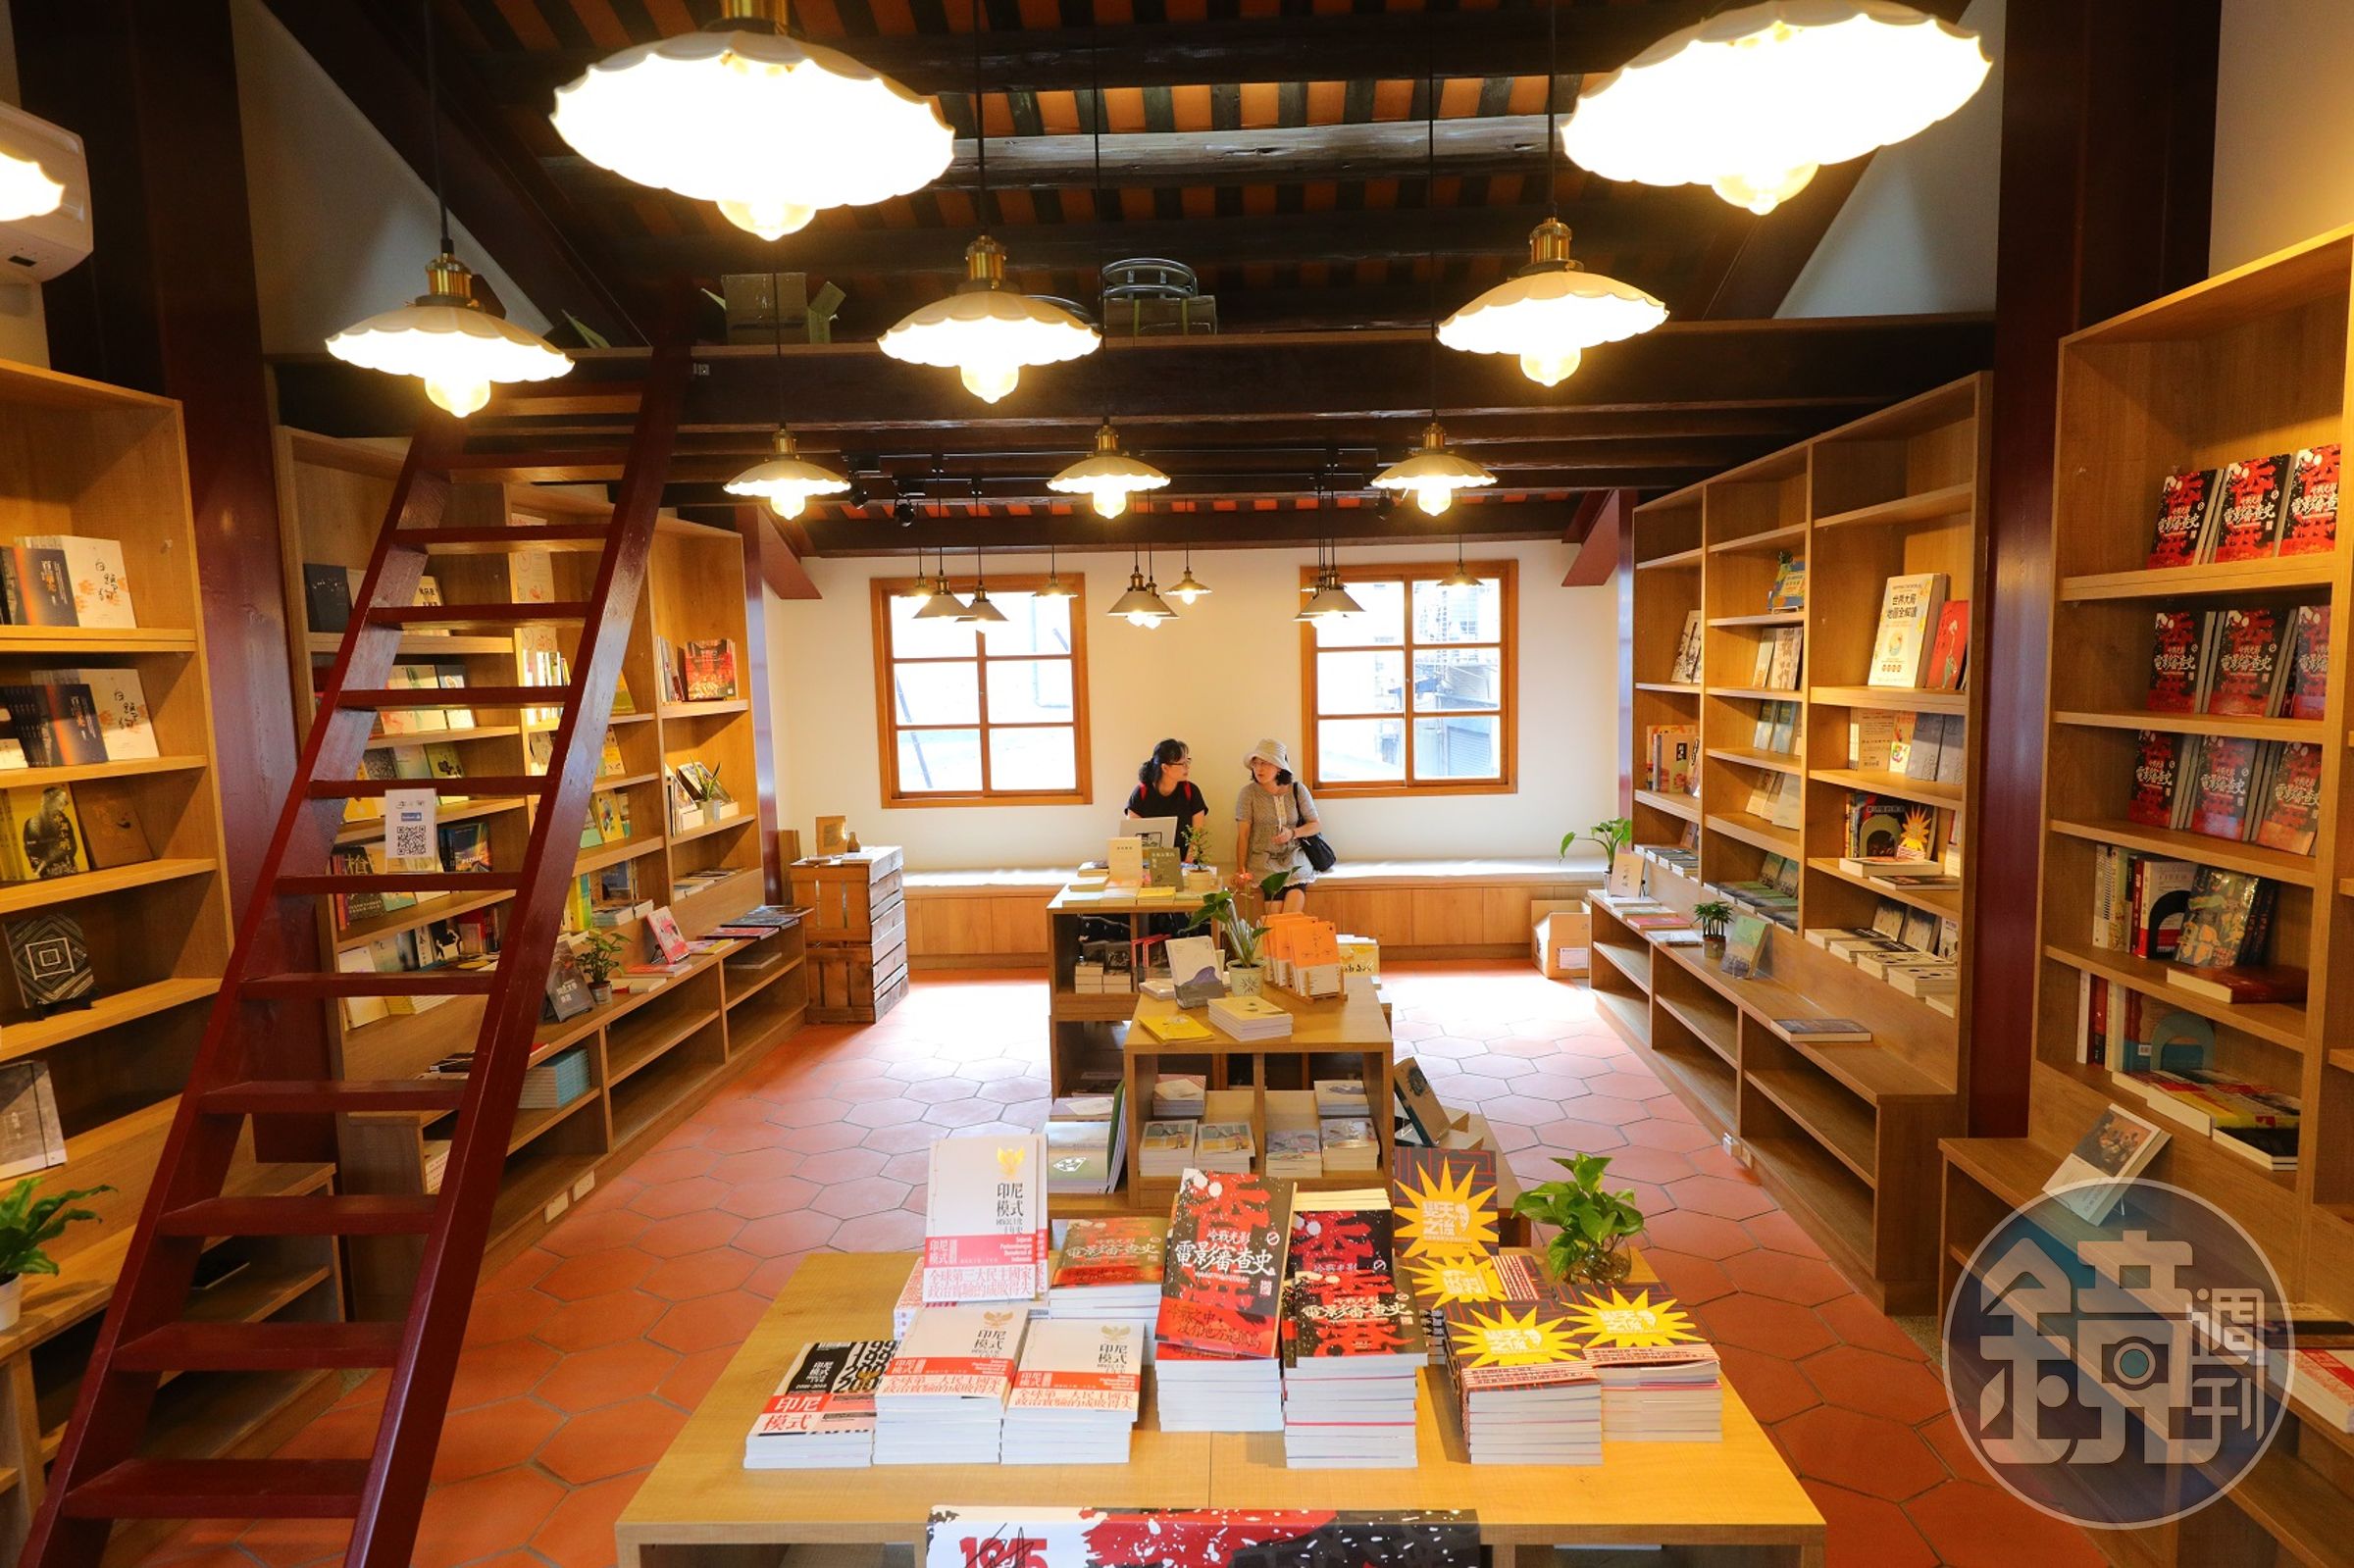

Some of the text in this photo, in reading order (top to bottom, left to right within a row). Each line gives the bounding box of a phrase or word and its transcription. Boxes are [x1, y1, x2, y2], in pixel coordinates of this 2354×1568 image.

[997, 1182, 1023, 1198] 印尼
[997, 1199, 1024, 1217] 模式
[930, 1239, 948, 1250] 印尼
[1206, 1229, 1252, 1245] 冷戰光影
[928, 1251, 948, 1264] 模式
[1174, 1239, 1277, 1276] 電影審查史
[1301, 1301, 1414, 1320] 電影審查史
[978, 1330, 1007, 1340] 印尼
[973, 1340, 1002, 1350] 模式
[1100, 1343, 1128, 1354] 印尼
[1098, 1353, 1128, 1365] 模式
[774, 1396, 822, 1412] 印尼
[763, 1414, 812, 1432] 模式
